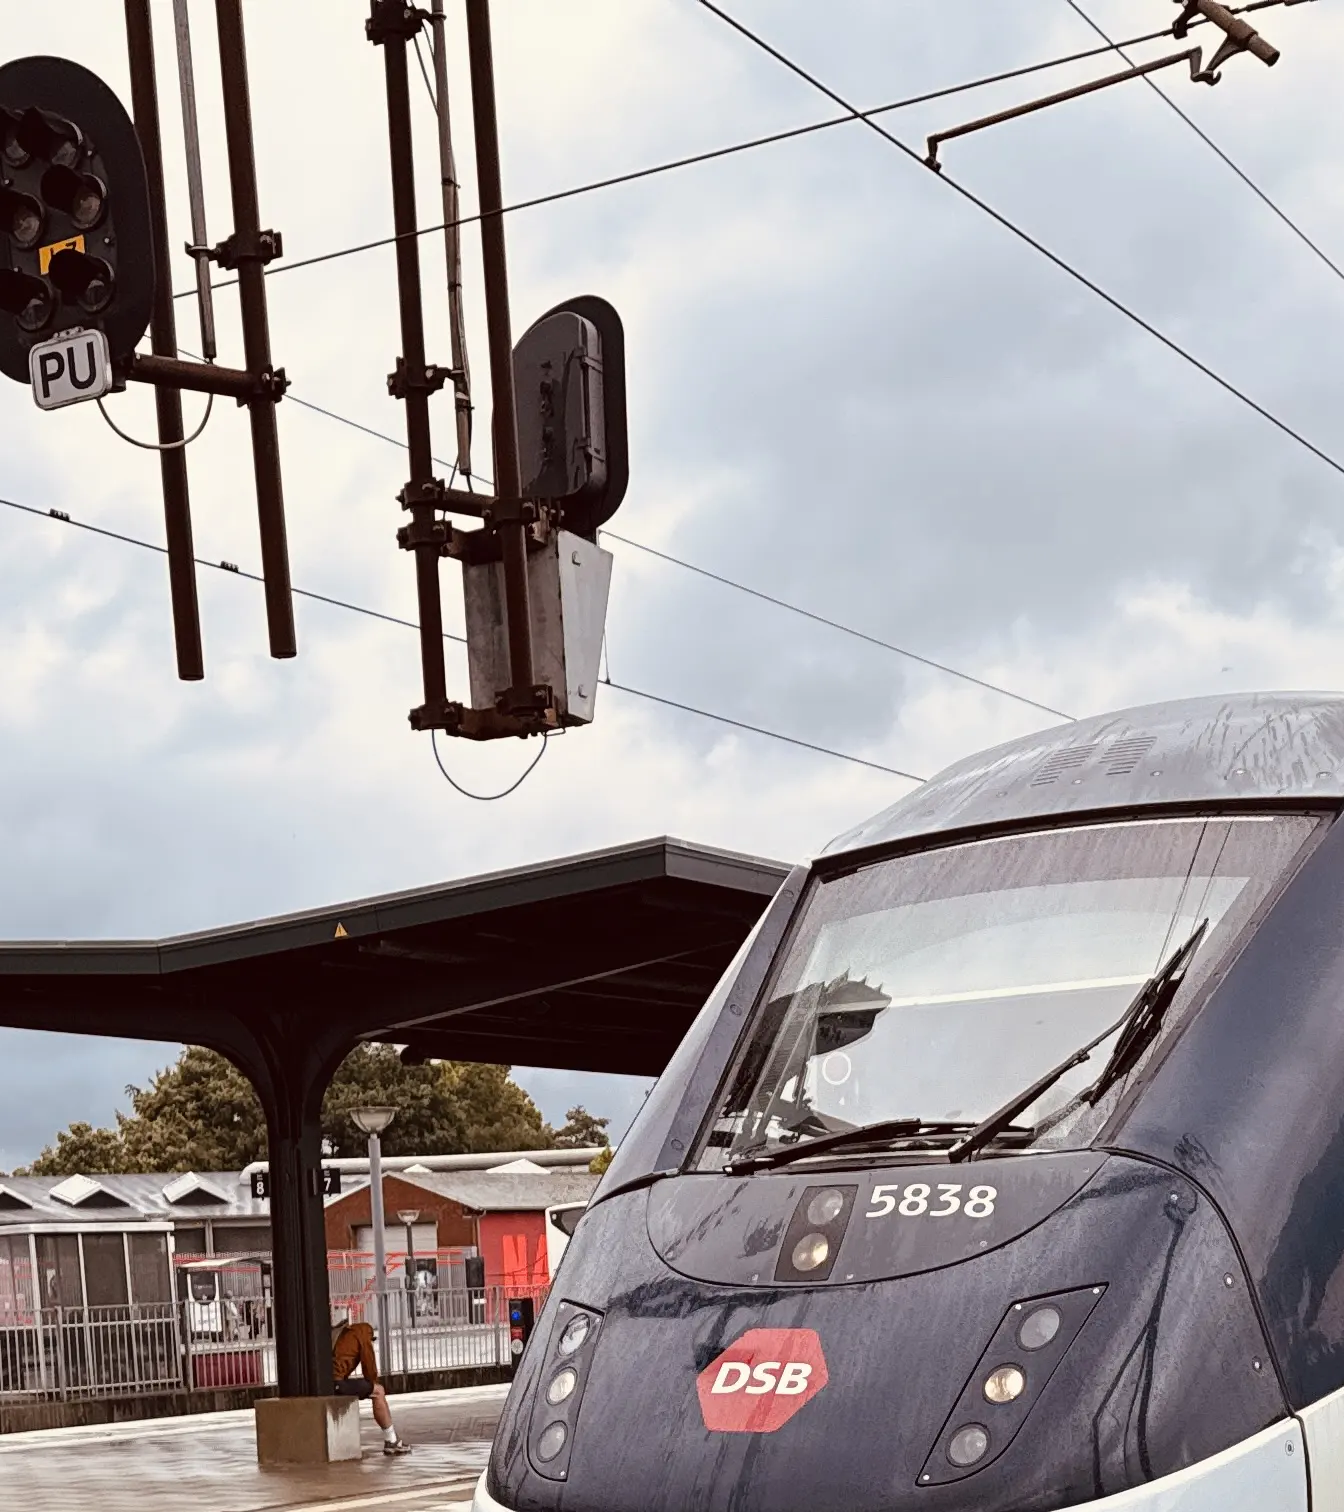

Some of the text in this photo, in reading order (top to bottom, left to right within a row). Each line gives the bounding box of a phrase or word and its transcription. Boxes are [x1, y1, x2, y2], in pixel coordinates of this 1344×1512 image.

[39, 341, 96, 398] PU
[256, 1181, 265, 1195] 8
[323, 1177, 332, 1192] 7
[865, 1183, 997, 1218] 5838
[711, 1361, 813, 1395] DSB
